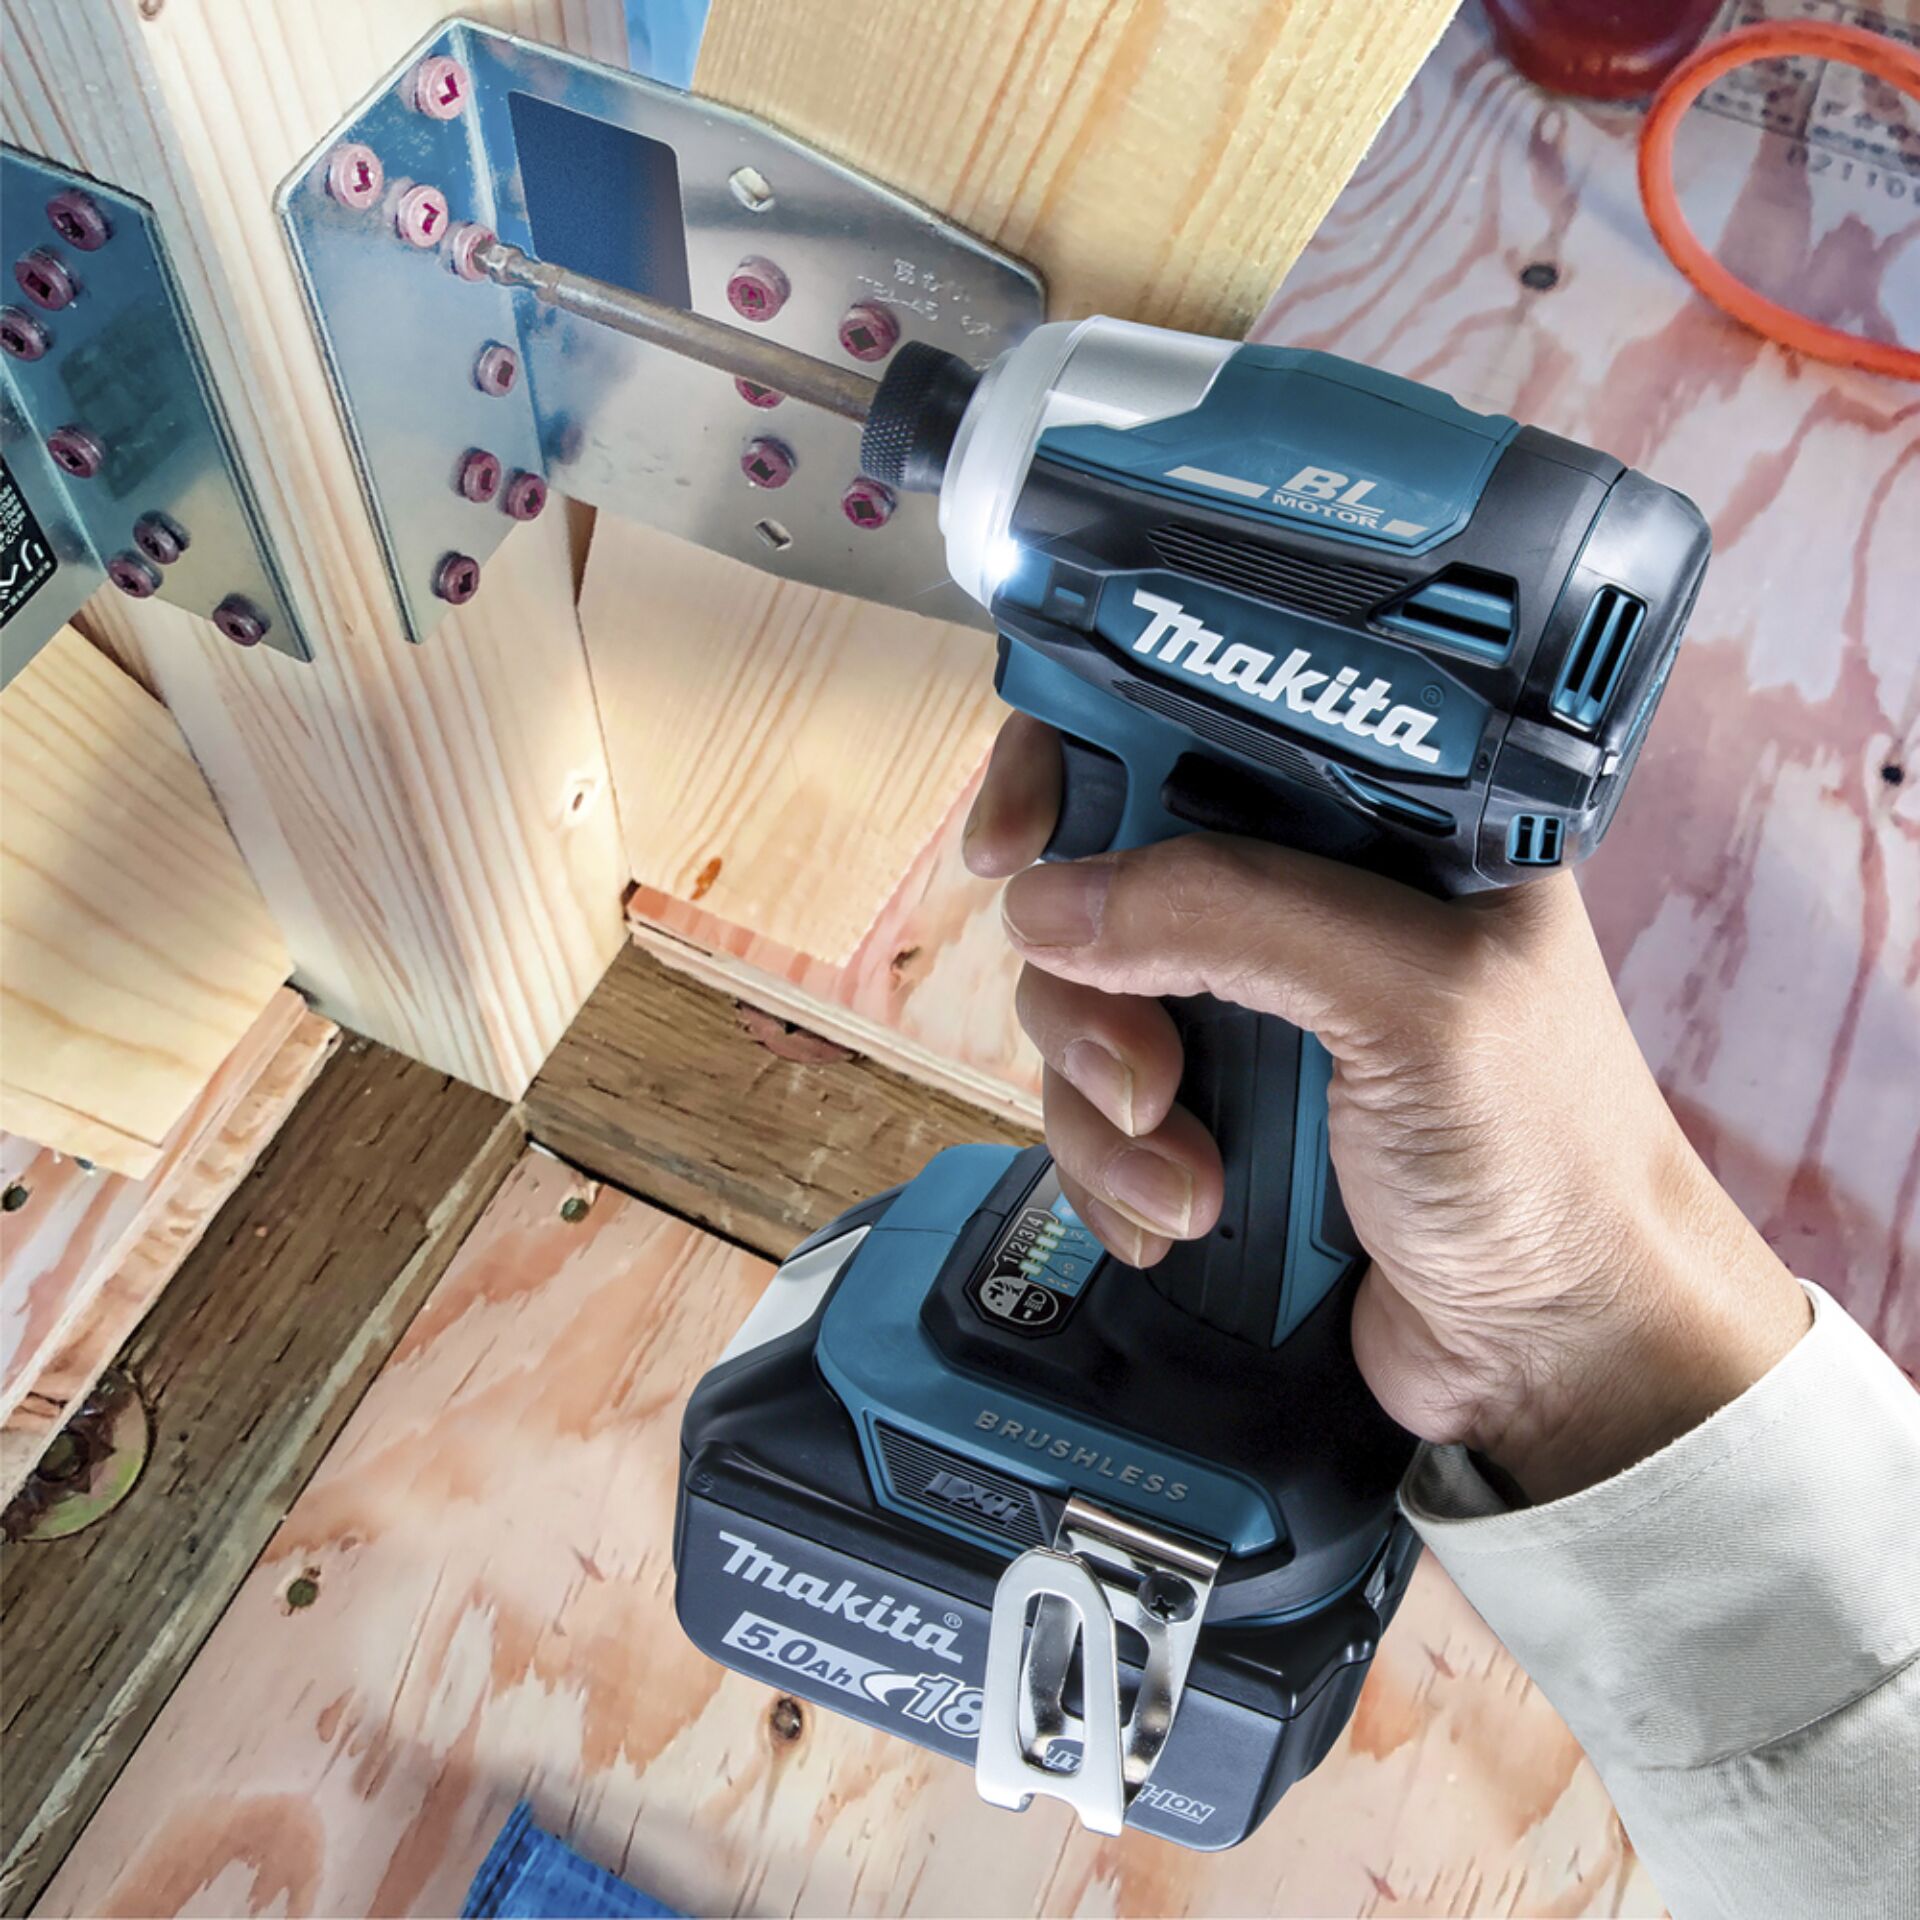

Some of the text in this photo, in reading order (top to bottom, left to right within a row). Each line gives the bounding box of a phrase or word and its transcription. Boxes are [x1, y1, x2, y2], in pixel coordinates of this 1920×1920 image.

[1271, 492, 1379, 530] MOTOR
[1282, 465, 1385, 515] BL
[974, 1409, 1190, 1501] BRUSHLESS
[736, 1621, 853, 1687] 5.0Ah
